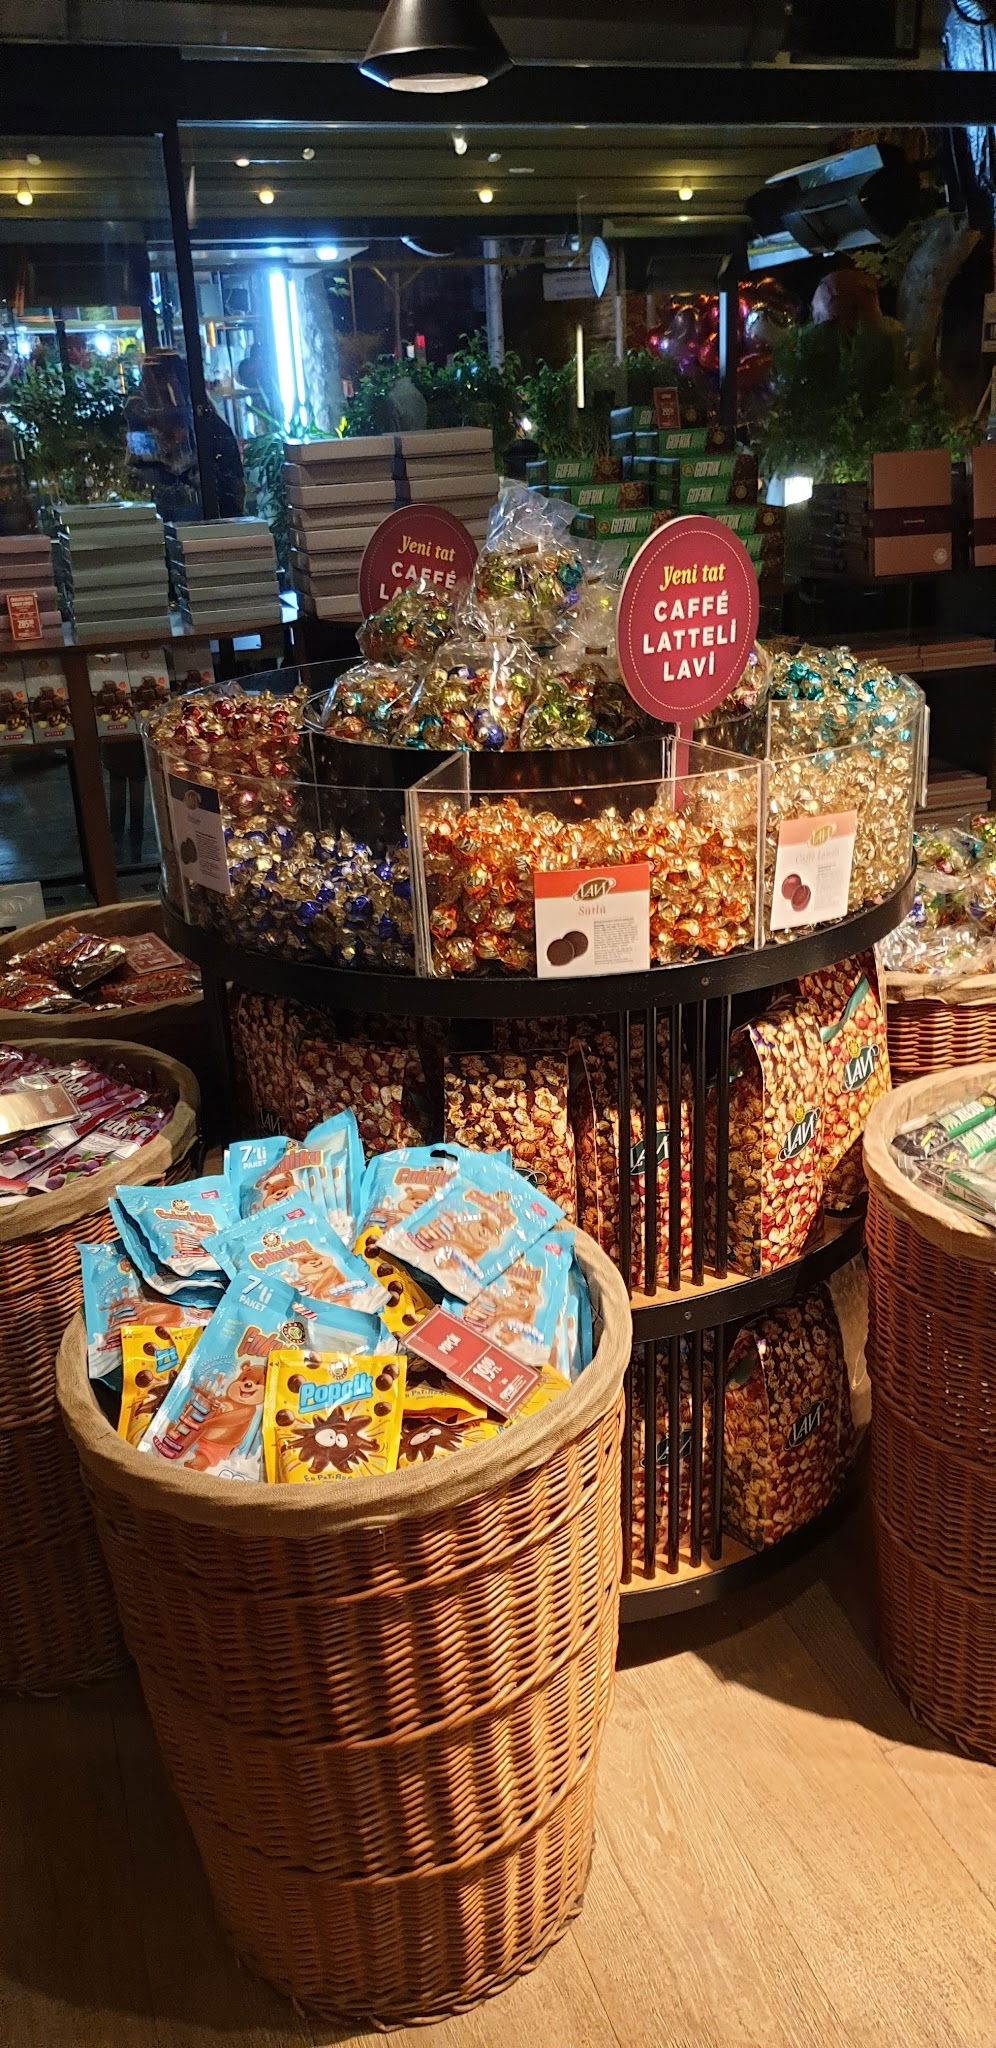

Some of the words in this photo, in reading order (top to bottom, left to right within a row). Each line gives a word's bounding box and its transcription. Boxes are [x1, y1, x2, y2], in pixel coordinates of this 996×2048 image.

[397, 535, 432, 557] Yeni
[435, 545, 456, 562] tat
[659, 564, 697, 592] Yeni
[701, 563, 726, 583] tat
[654, 590, 729, 622] CAFFÉ
[642, 618, 737, 654] LATTELİ
[663, 655, 715, 682] LAVİ
[242, 1160, 267, 1169] PAKET
[239, 1295, 267, 1313] PAKET
